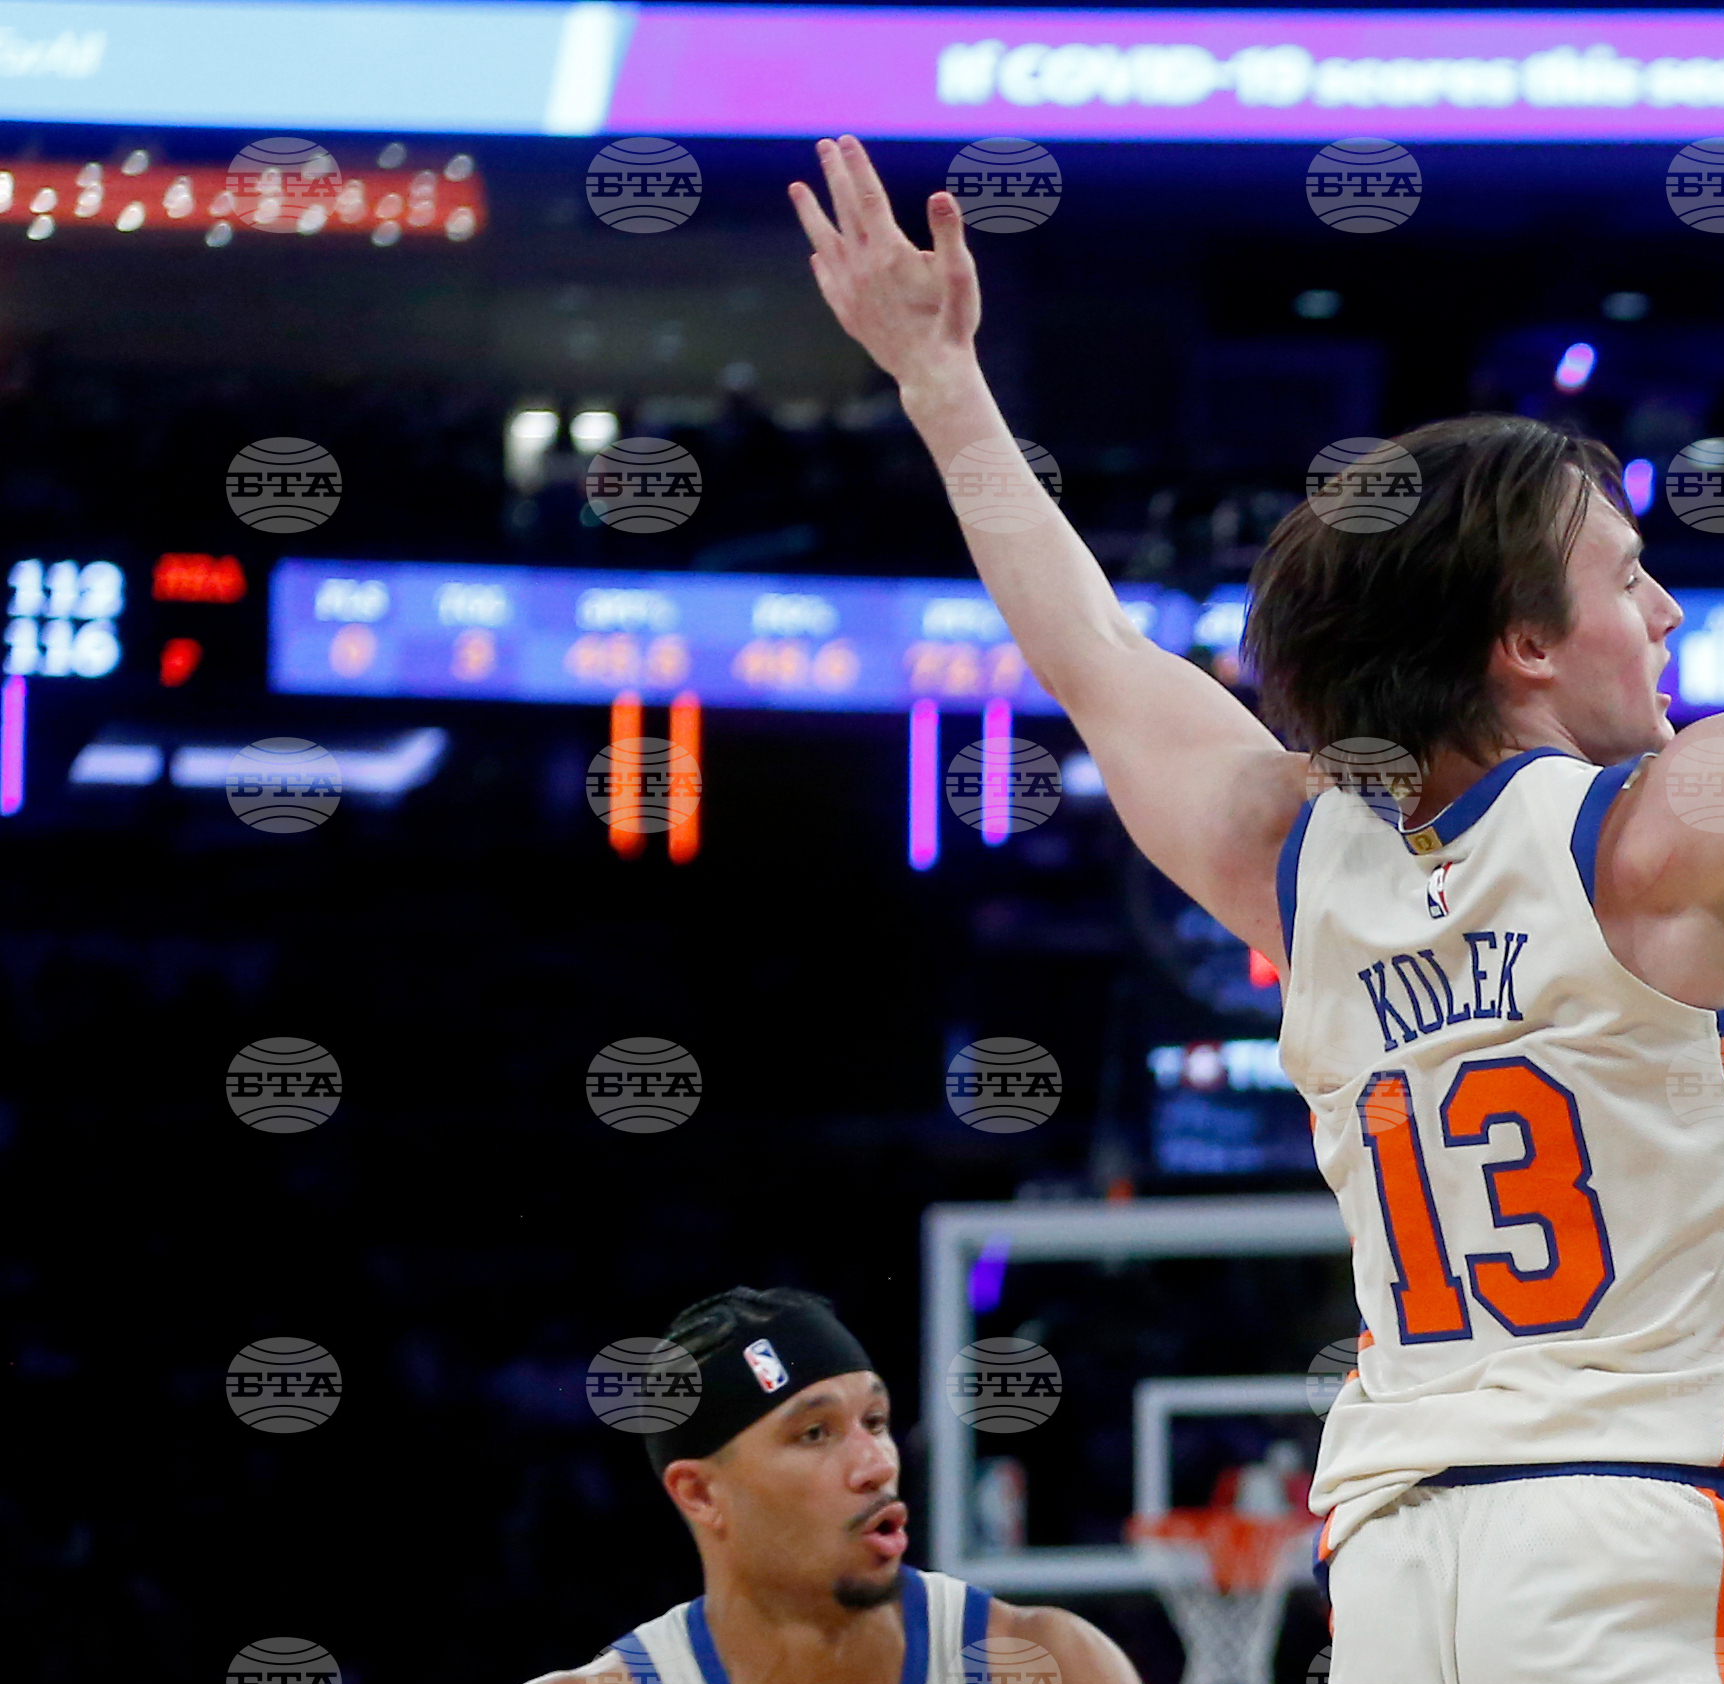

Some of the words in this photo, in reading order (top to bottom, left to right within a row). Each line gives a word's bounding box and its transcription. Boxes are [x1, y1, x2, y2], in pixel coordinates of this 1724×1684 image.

[999, 44, 1314, 106] COVID-19
[1358, 931, 1528, 1051] KOLEK
[1356, 1055, 1616, 1345] 13
